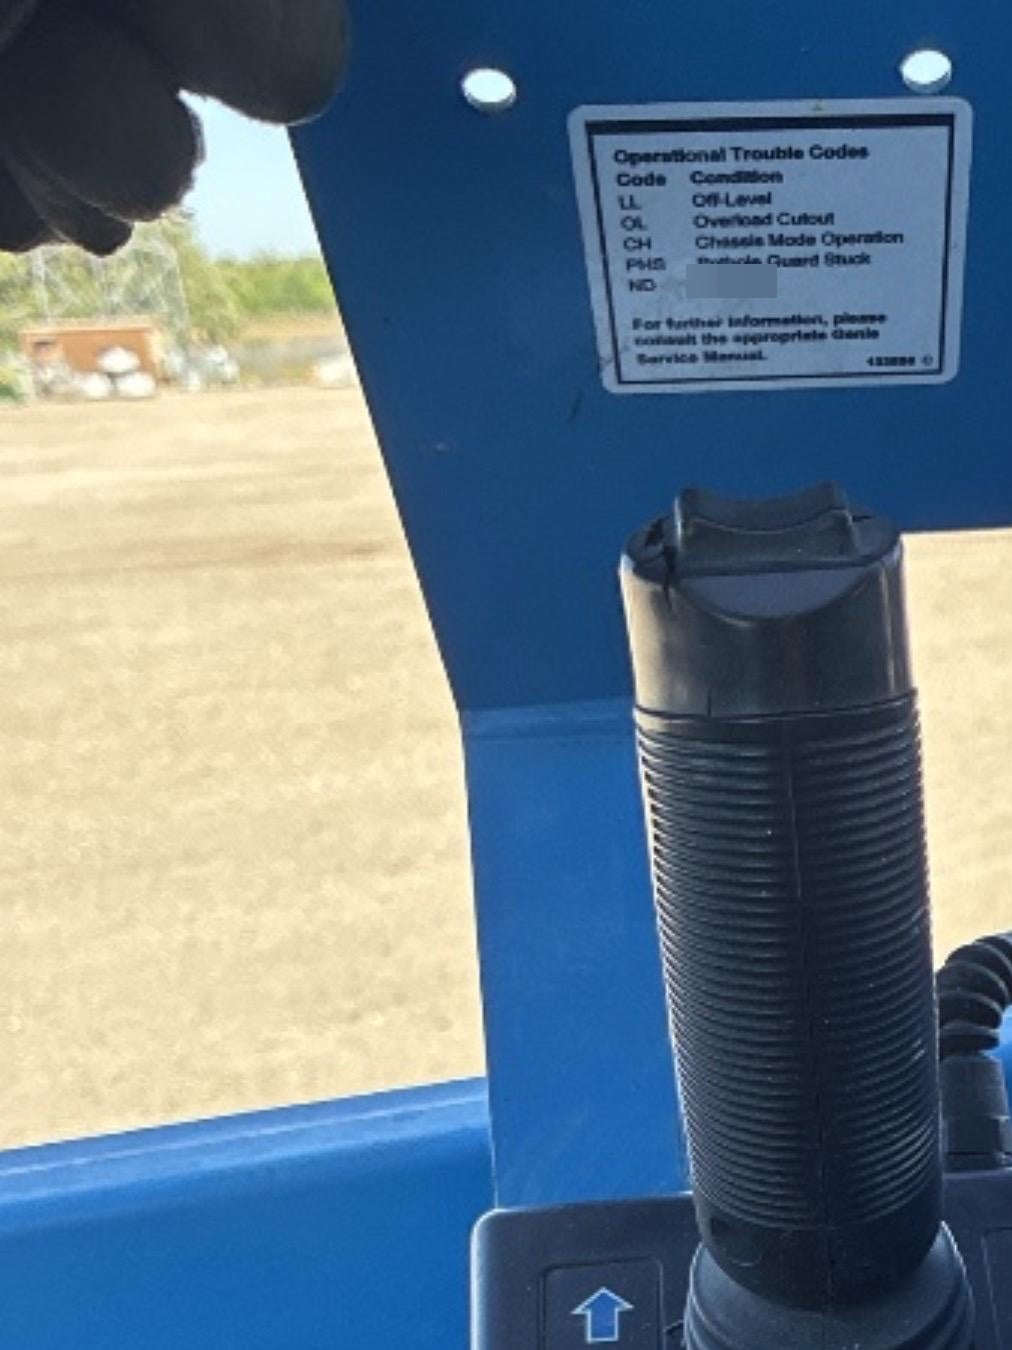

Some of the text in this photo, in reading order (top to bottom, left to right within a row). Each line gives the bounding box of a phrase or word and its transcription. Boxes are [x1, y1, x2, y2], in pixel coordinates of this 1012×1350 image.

[613, 143, 869, 166] Operational Trouble Codes
[616, 170, 783, 187] Code Condition
[618, 191, 772, 211] LL Off-Level
[620, 211, 835, 231] OL Overload Cutout
[623, 230, 904, 252] CH Chassis Mode Operation
[766, 253, 820, 268] Guard
[824, 251, 872, 265] Stuck
[629, 278, 657, 292] ND
[631, 317, 662, 331] For
[727, 314, 829, 328] information,
[833, 312, 887, 327] please
[701, 332, 728, 345] the
[731, 329, 828, 345] appropriate
